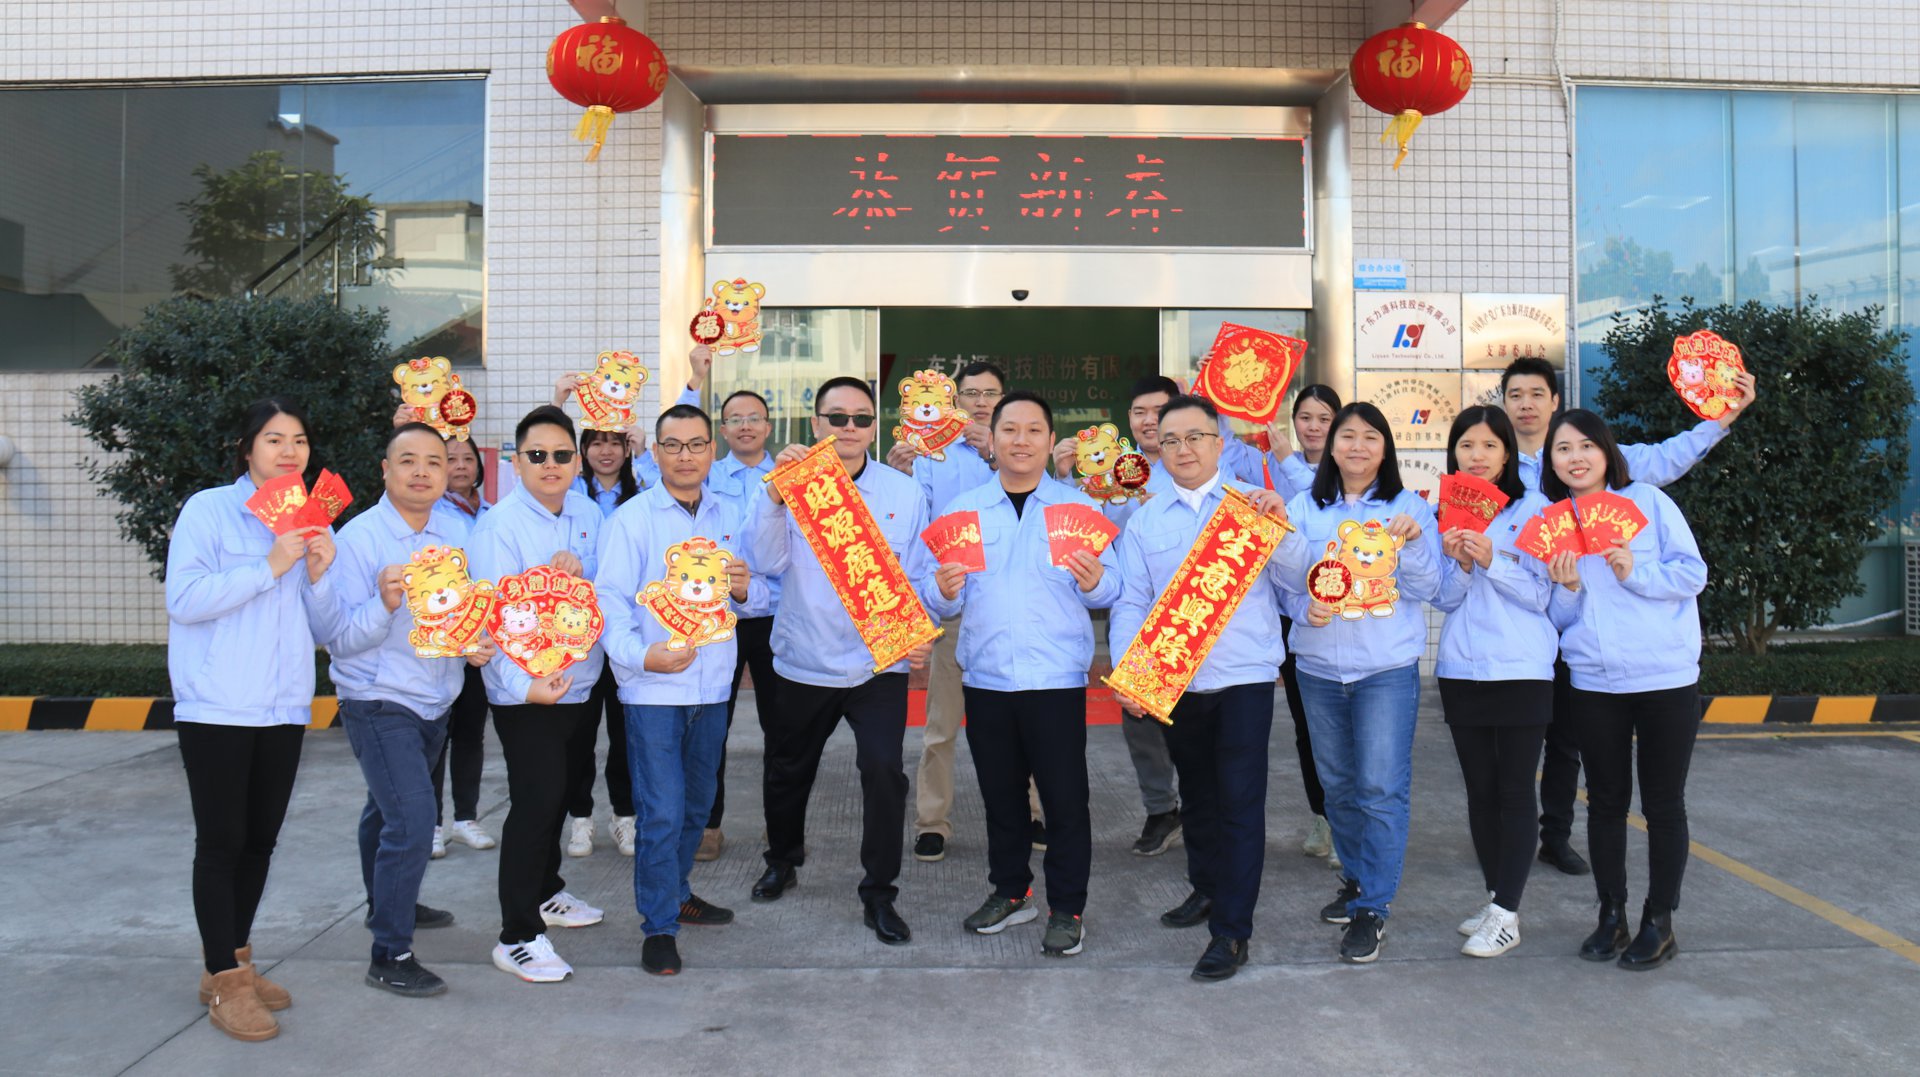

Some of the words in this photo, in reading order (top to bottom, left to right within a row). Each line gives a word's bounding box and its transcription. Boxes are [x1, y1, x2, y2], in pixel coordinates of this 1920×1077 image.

[576, 34, 621, 75] 福
[1376, 38, 1420, 79] 福
[506, 575, 591, 602] 身體健康
[1315, 567, 1347, 598] 福
